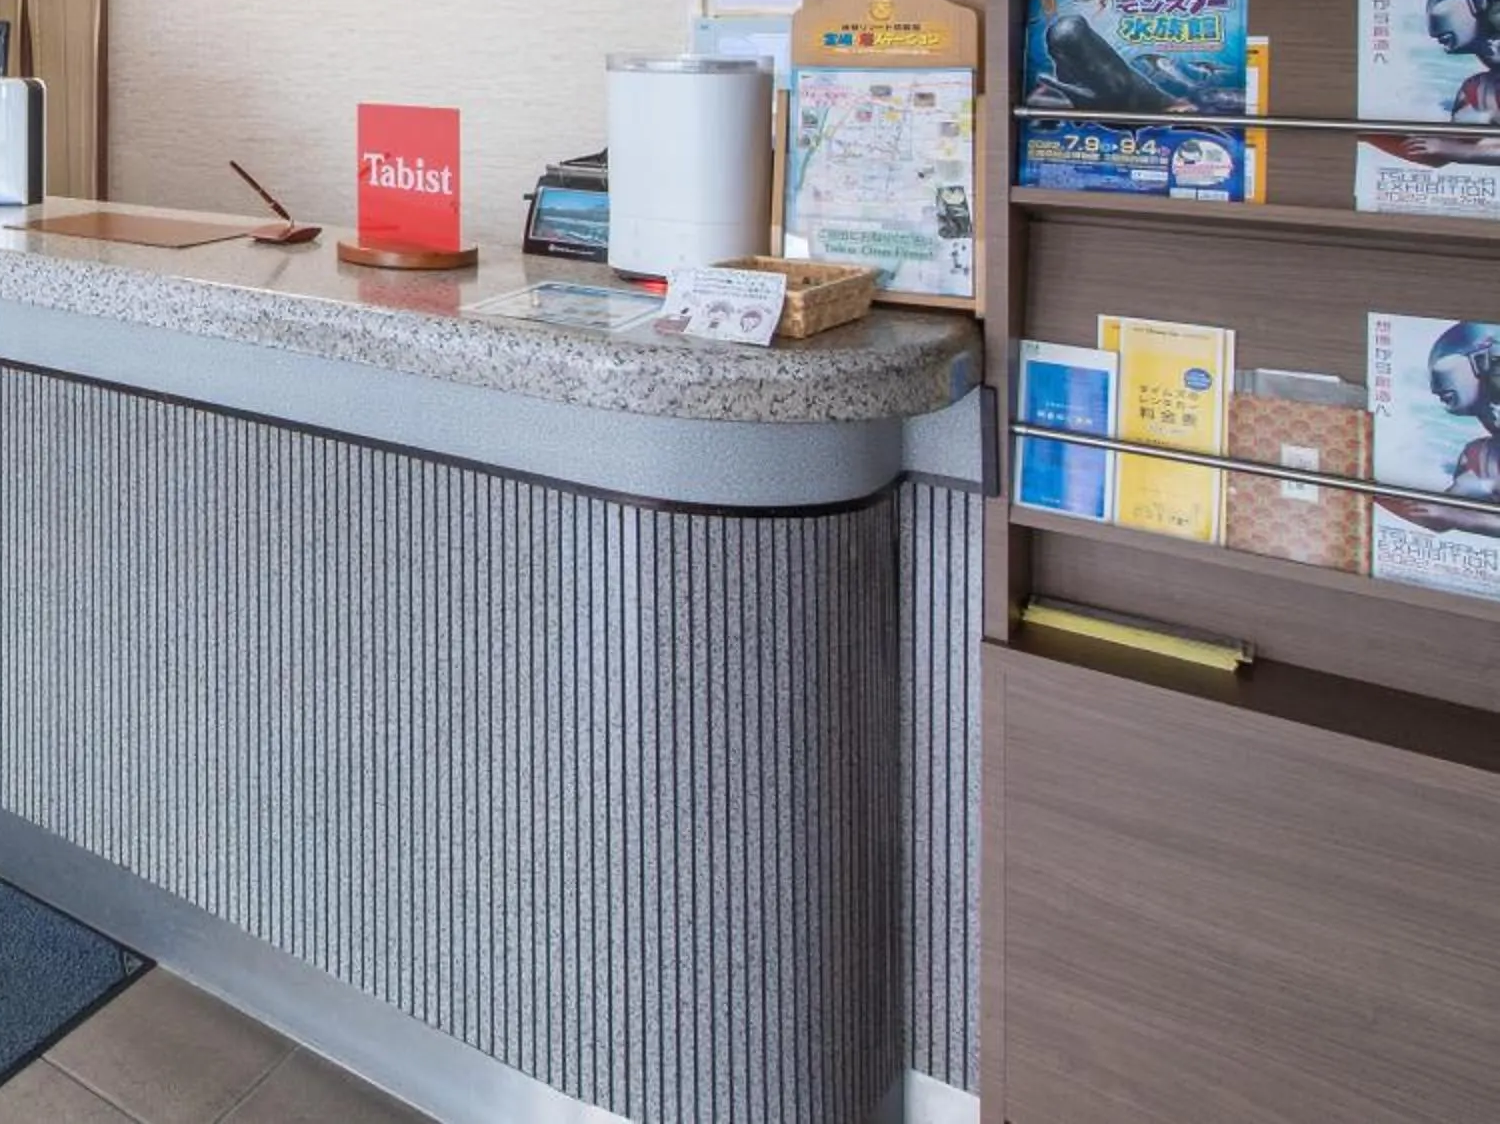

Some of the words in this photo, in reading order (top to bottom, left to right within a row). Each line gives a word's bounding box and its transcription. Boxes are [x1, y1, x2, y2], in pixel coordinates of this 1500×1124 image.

[1119, 14, 1222, 41] 水族館
[1063, 135, 1100, 151] 7.9
[1120, 138, 1157, 155] 9.4
[363, 152, 453, 195] Tabist
[1377, 181, 1495, 196] EXHIBITION
